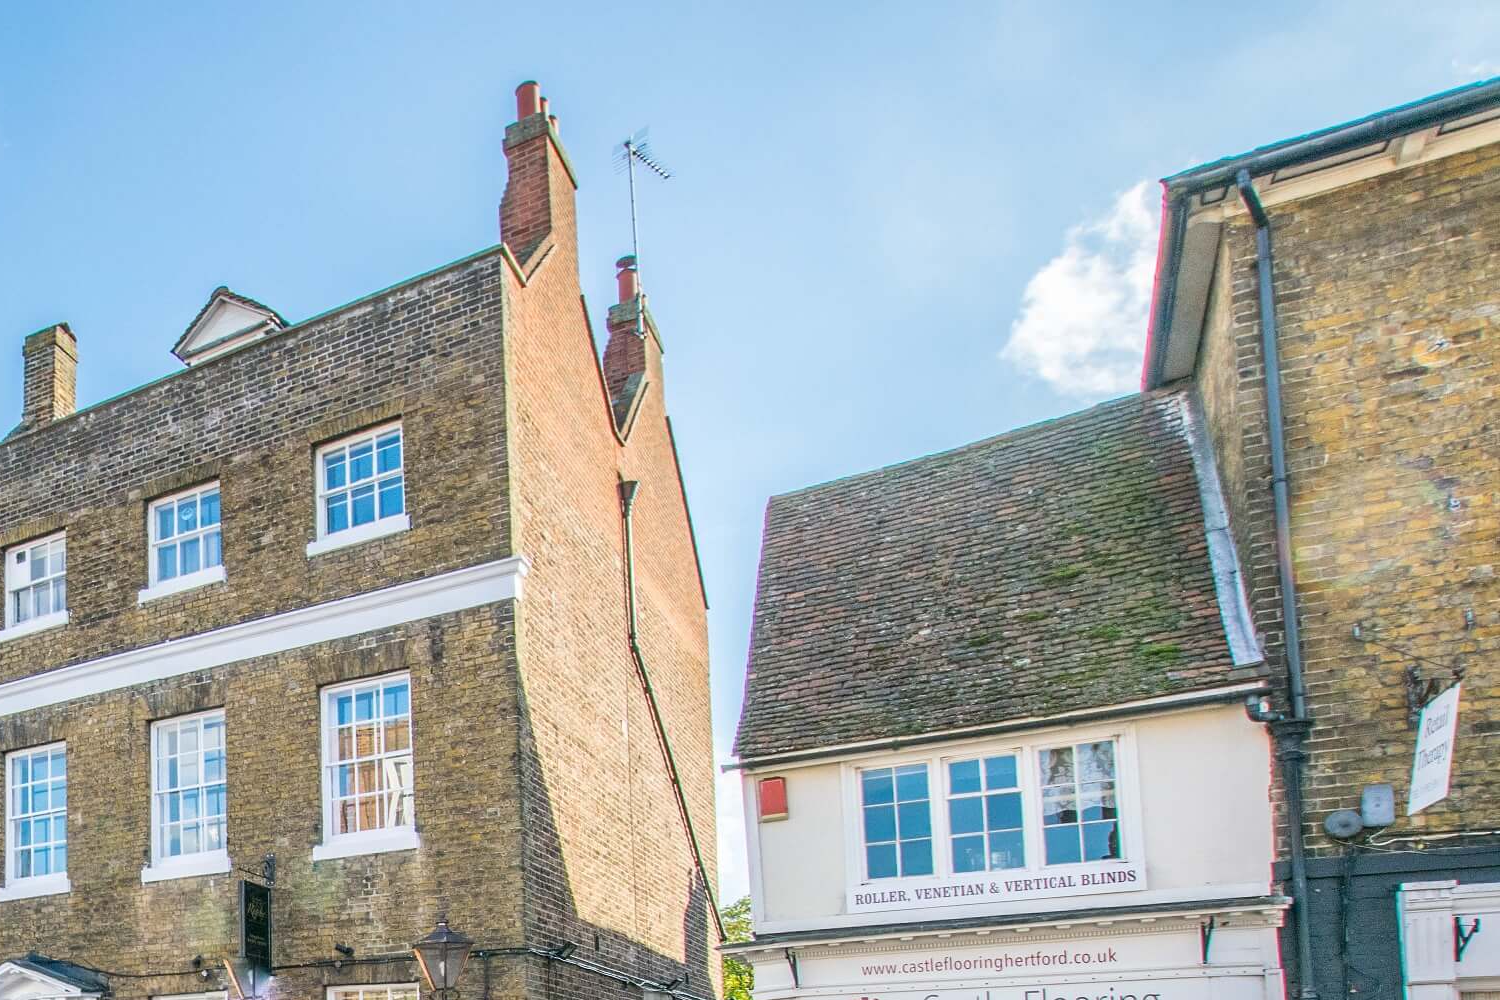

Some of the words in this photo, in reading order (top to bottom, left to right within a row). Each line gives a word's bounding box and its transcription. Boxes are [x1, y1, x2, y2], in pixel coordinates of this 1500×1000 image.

[915, 883, 984, 901] VENETIAN
[989, 882, 999, 894] &
[1004, 876, 1076, 892] VERTICAL
[1081, 870, 1137, 886] BLINDS
[861, 948, 1117, 976] www.castleflooringhertford.co.uk
